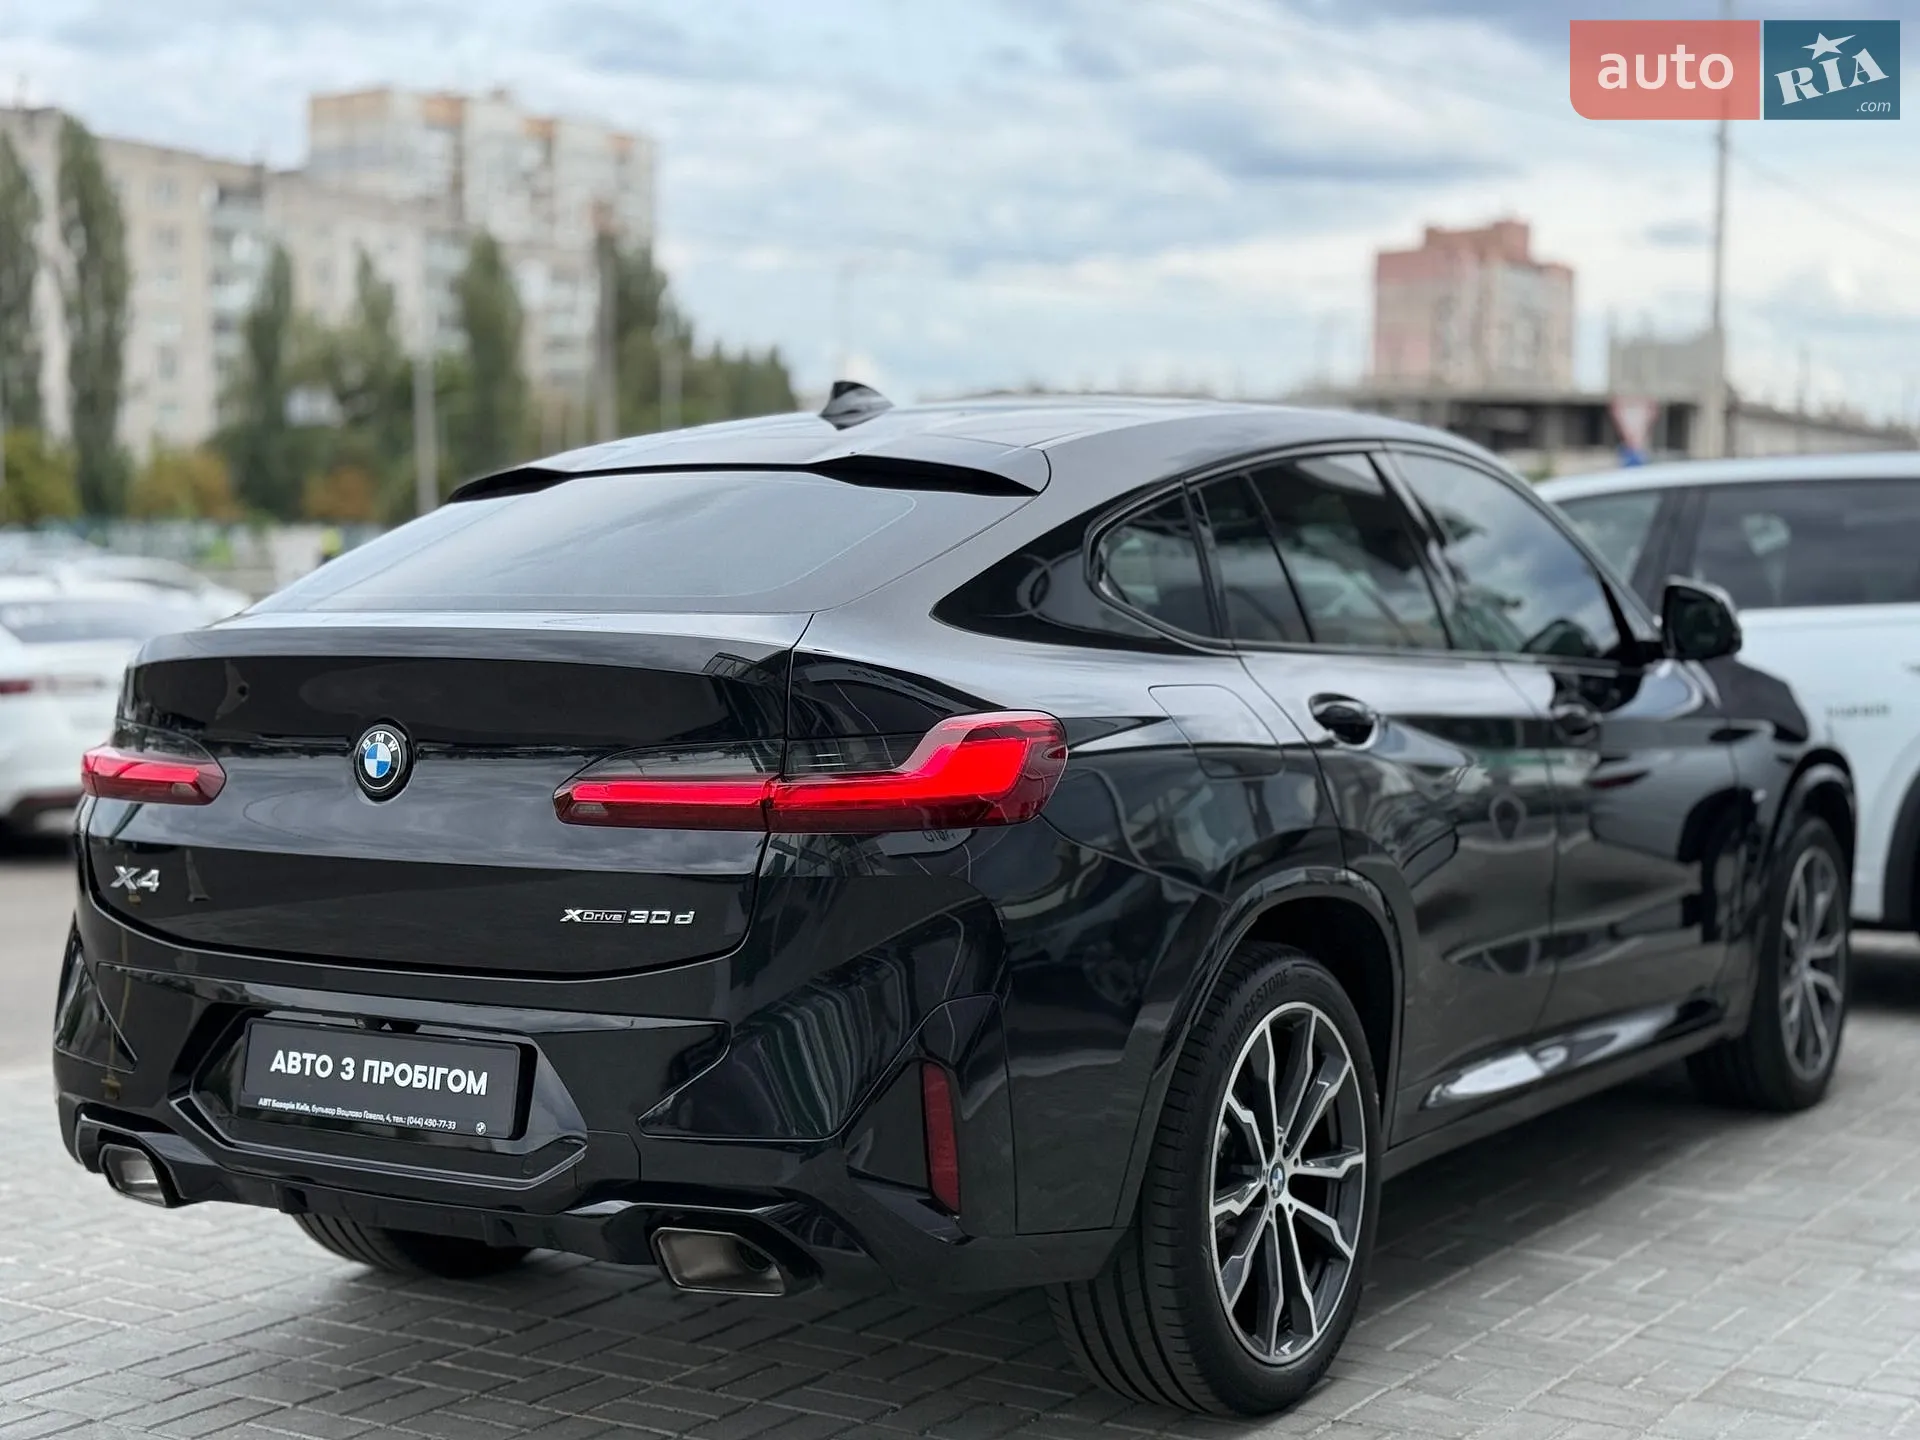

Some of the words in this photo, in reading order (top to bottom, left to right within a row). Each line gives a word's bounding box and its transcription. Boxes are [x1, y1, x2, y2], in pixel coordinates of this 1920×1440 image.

[362, 733, 398, 752] BMW
[110, 866, 160, 893] X4
[270, 1050, 334, 1078] АВТО
[362, 1059, 488, 1096] ПРОБІГОМ
[424, 1117, 457, 1130] 490-77-33
